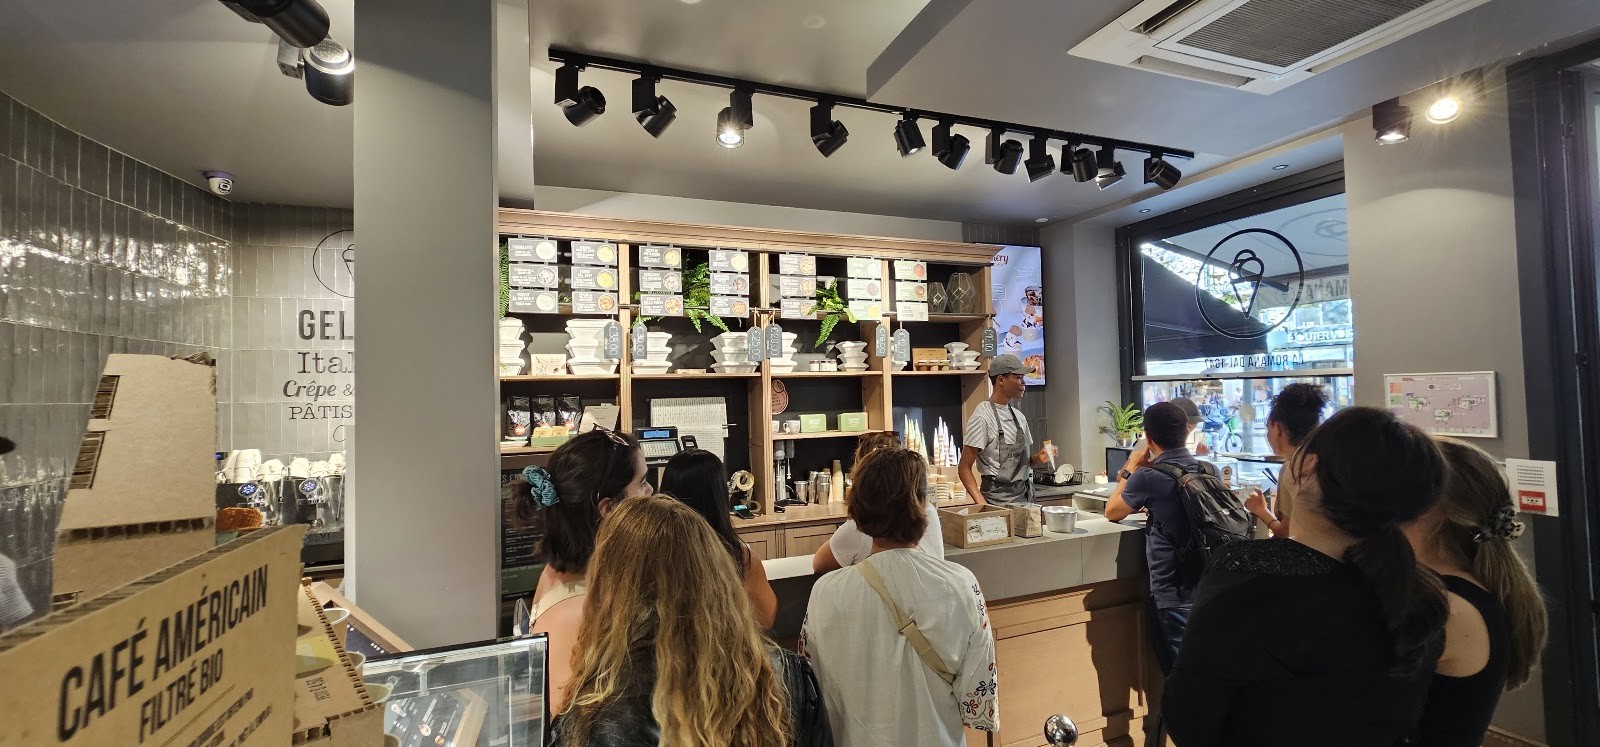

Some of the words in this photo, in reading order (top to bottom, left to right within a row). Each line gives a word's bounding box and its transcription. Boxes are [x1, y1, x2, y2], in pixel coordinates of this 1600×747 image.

[298, 309, 354, 340] GEL
[282, 380, 336, 401] Crêpe
[343, 383, 354, 396] &
[289, 402, 353, 420] PÂTIS
[56, 616, 148, 743] CAFÉ
[152, 563, 268, 681] AMÉRICAIN
[138, 659, 198, 744] FILTRÉ
[199, 648, 224, 696] BIO
